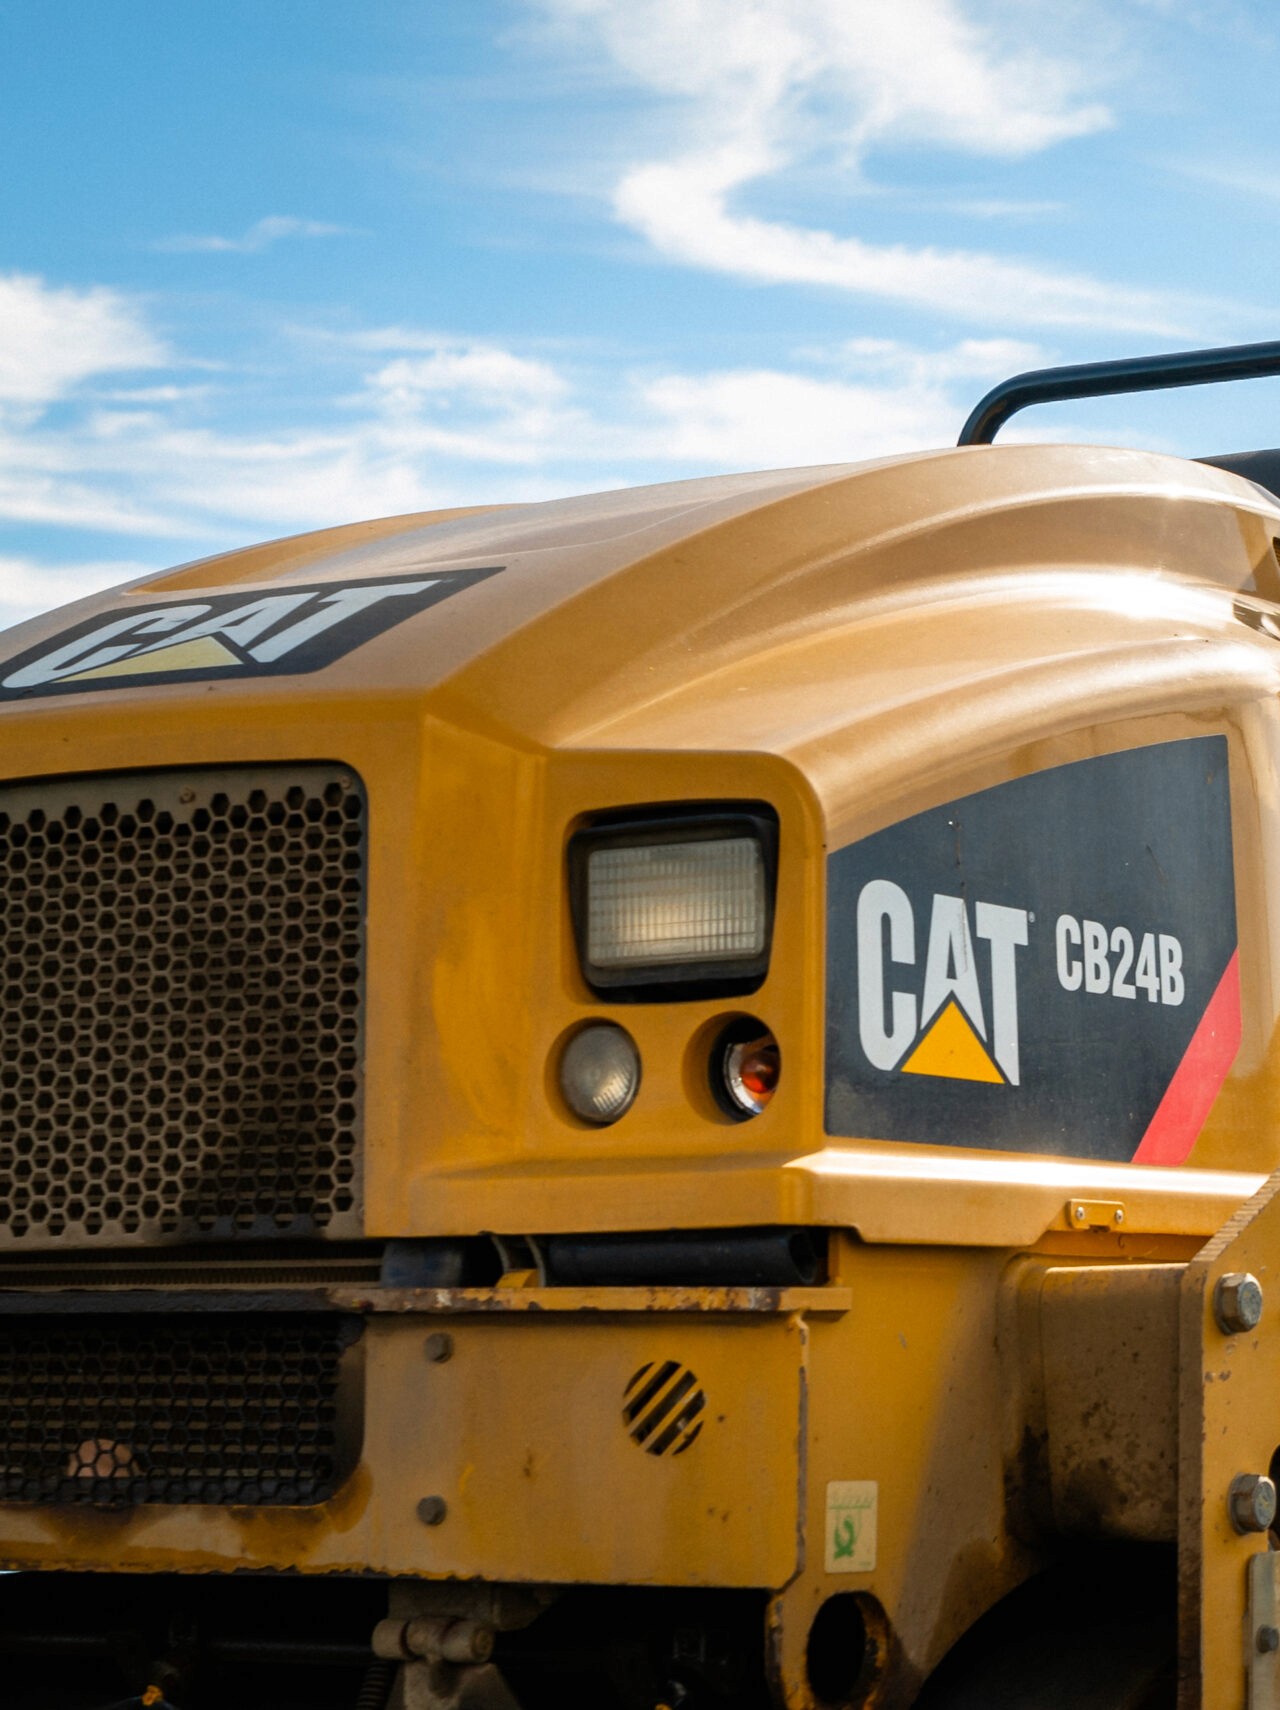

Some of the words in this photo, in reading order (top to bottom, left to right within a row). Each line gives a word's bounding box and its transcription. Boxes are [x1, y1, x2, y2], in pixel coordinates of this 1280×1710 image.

[1, 579, 443, 688] CAT
[857, 879, 1029, 1086] CAT
[1055, 913, 1185, 1007] CB24B
